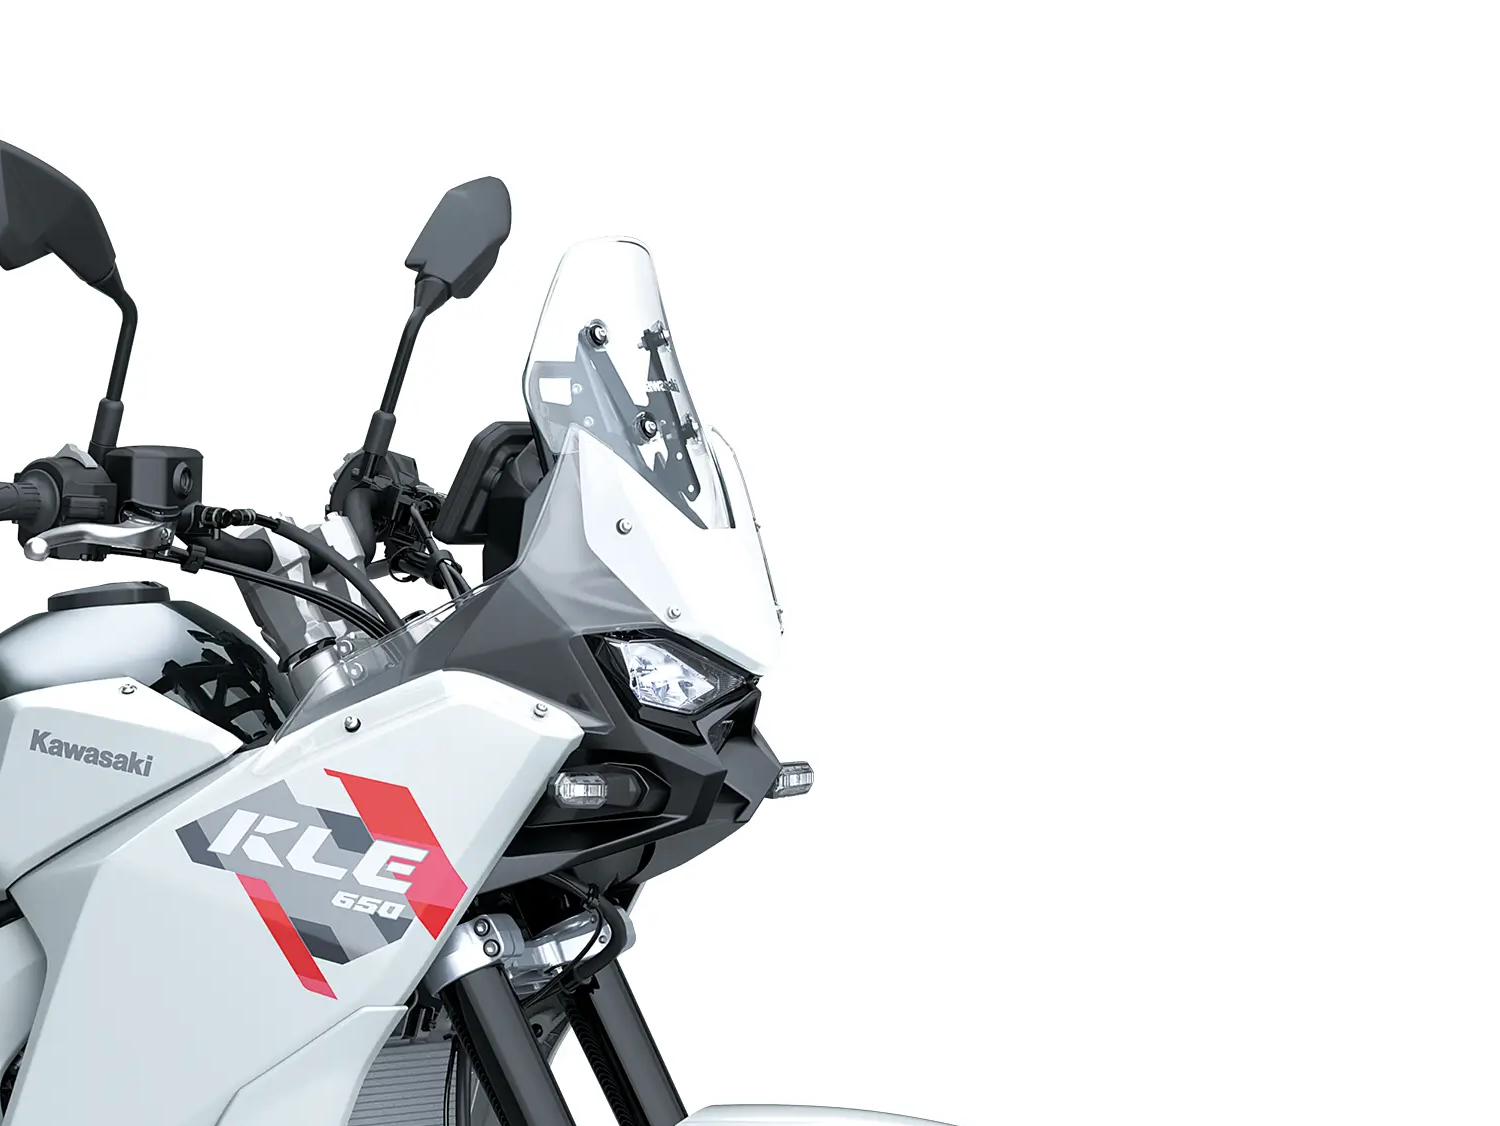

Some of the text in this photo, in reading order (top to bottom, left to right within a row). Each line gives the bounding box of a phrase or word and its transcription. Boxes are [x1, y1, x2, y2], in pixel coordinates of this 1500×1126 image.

[29, 728, 155, 777] Kawasaki
[207, 808, 430, 894] KLE
[331, 889, 406, 920] 650
